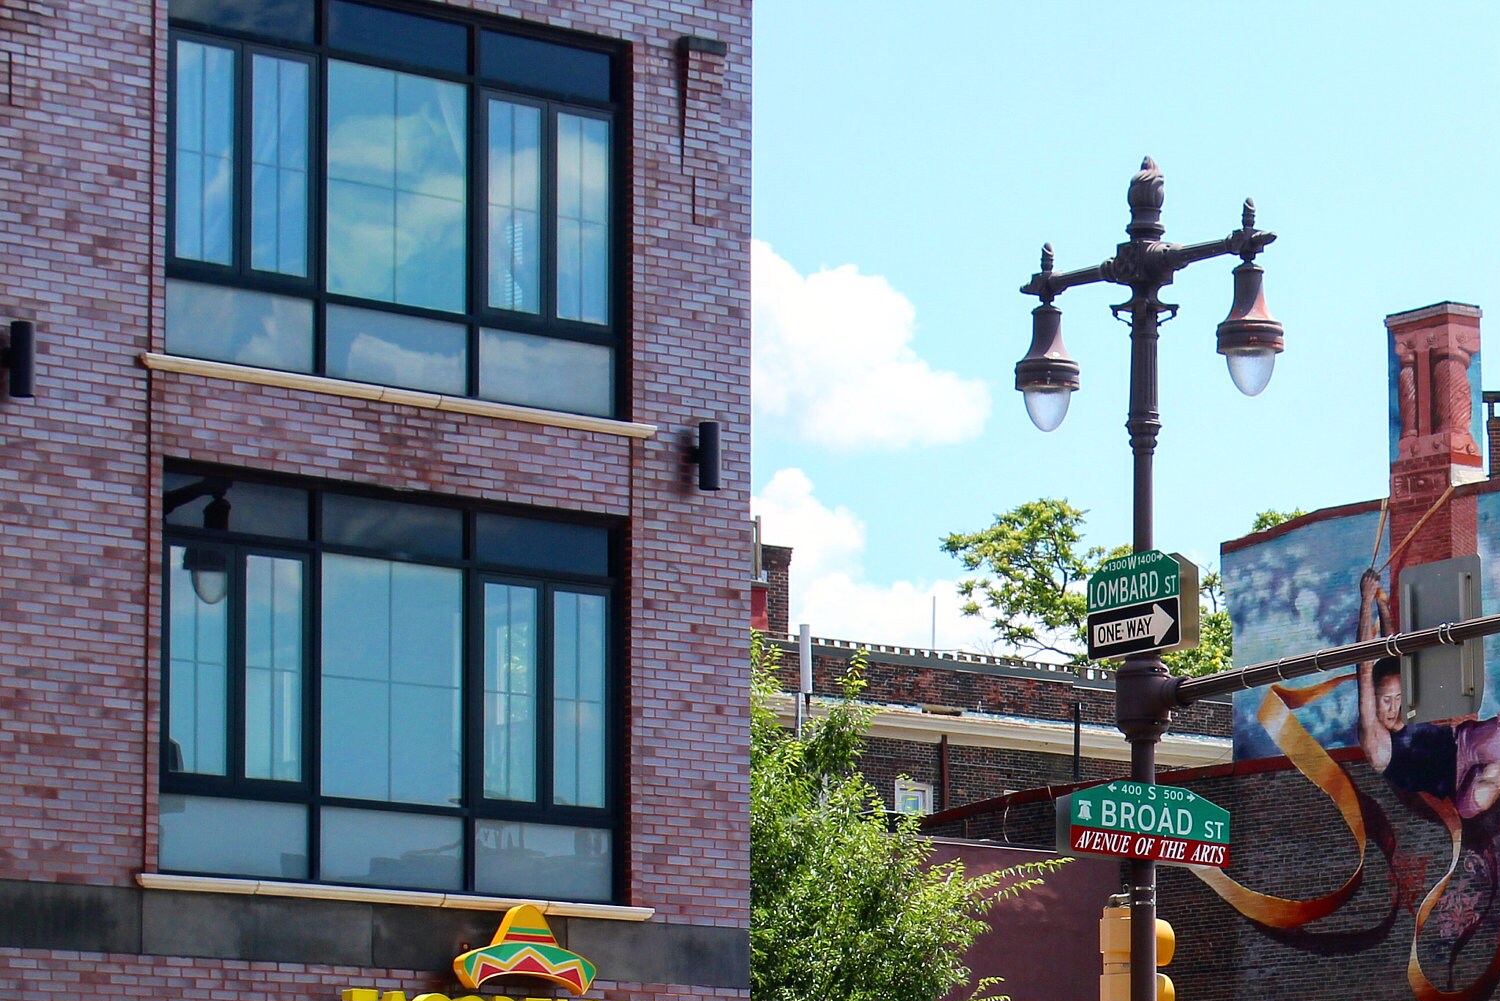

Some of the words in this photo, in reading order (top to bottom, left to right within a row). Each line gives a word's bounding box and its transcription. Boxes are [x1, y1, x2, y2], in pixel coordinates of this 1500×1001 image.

[1108, 559, 1127, 571] 1300
[1128, 555, 1137, 570] W
[1137, 553, 1157, 565] 1400
[1090, 570, 1159, 609] LOMBARD
[1164, 575, 1176, 594] ST
[1098, 623, 1122, 643] ONE
[1126, 616, 1152, 639] WAY
[1121, 784, 1142, 796] 400
[1148, 786, 1156, 800] S
[1164, 789, 1184, 801] 500
[1101, 799, 1193, 835] BROAD
[1204, 820, 1224, 840] ST
[1075, 830, 1131, 854] AVENUE
[1135, 837, 1155, 856] OF
[1158, 838, 1187, 860] THE
[1190, 844, 1226, 865] ARTS
